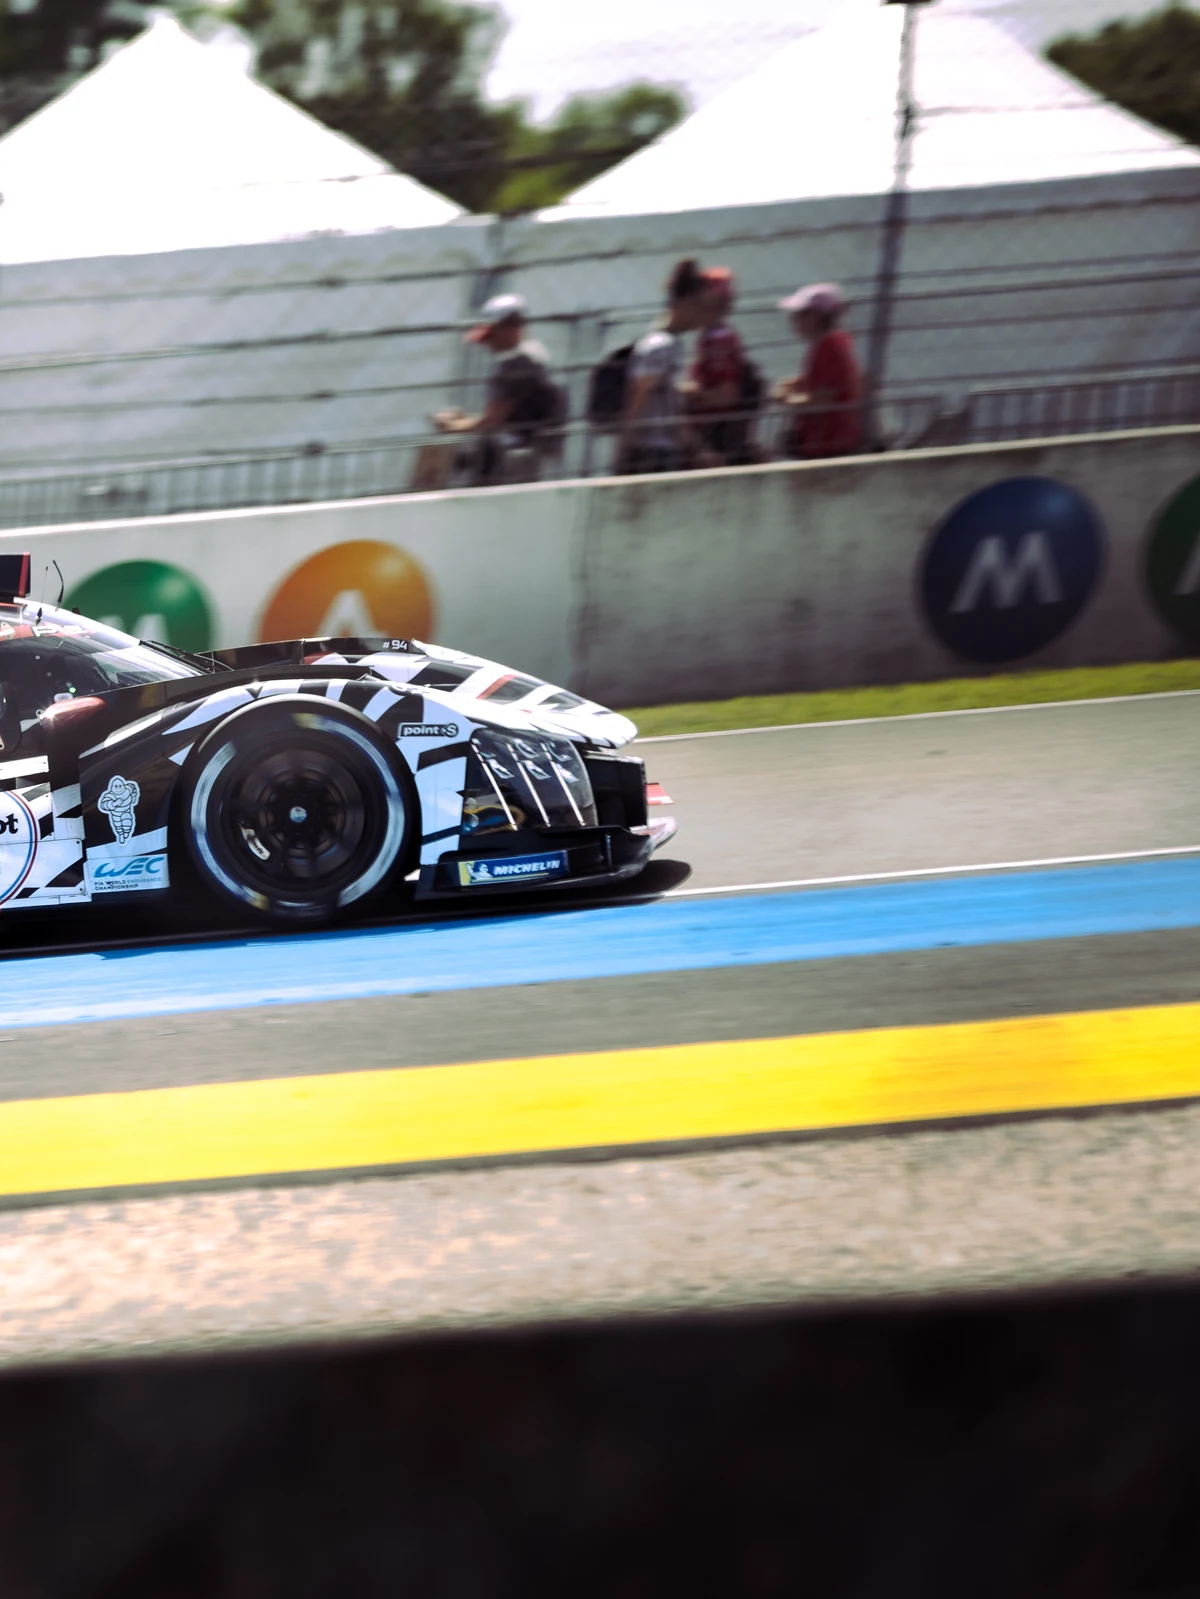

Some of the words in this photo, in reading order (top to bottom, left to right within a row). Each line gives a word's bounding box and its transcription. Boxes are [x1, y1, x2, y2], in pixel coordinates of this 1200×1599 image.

[945, 528, 1067, 613] M
[383, 639, 408, 651] #94
[403, 725, 440, 736] point
[94, 856, 165, 878] WEC
[494, 859, 561, 877] MICHELIN
